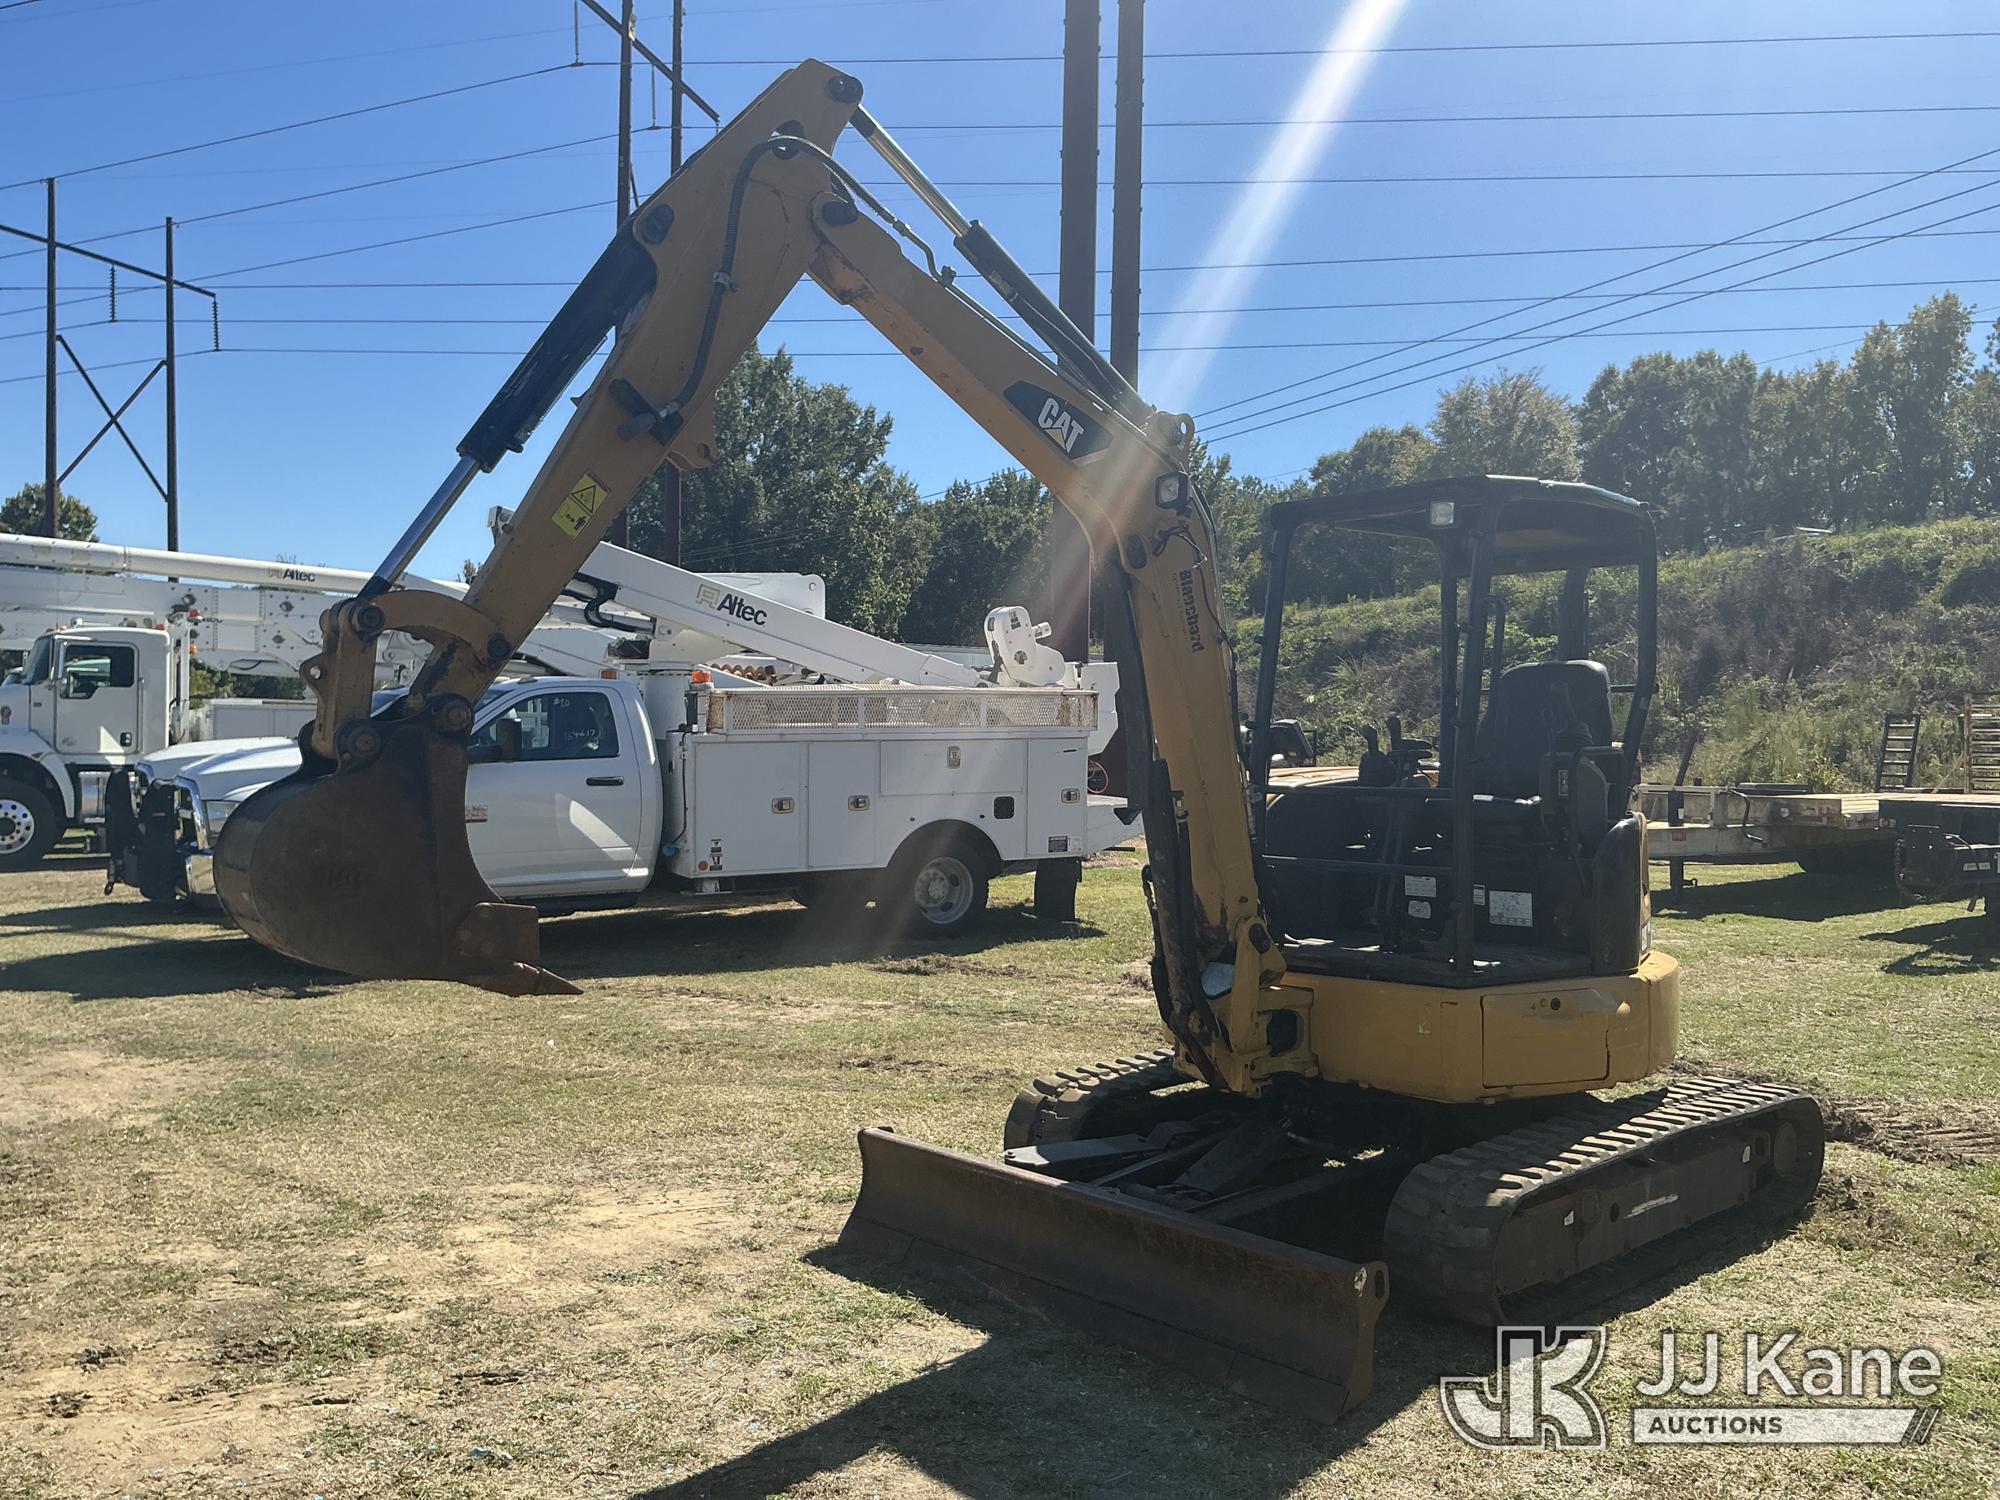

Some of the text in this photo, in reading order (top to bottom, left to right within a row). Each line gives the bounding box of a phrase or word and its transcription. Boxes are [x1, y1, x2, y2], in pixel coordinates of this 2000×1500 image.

[1038, 398, 1084, 453] CAT
[283, 569, 316, 581] Altec
[717, 593, 768, 625] Altec
[1179, 570, 1205, 653] Blanchard
